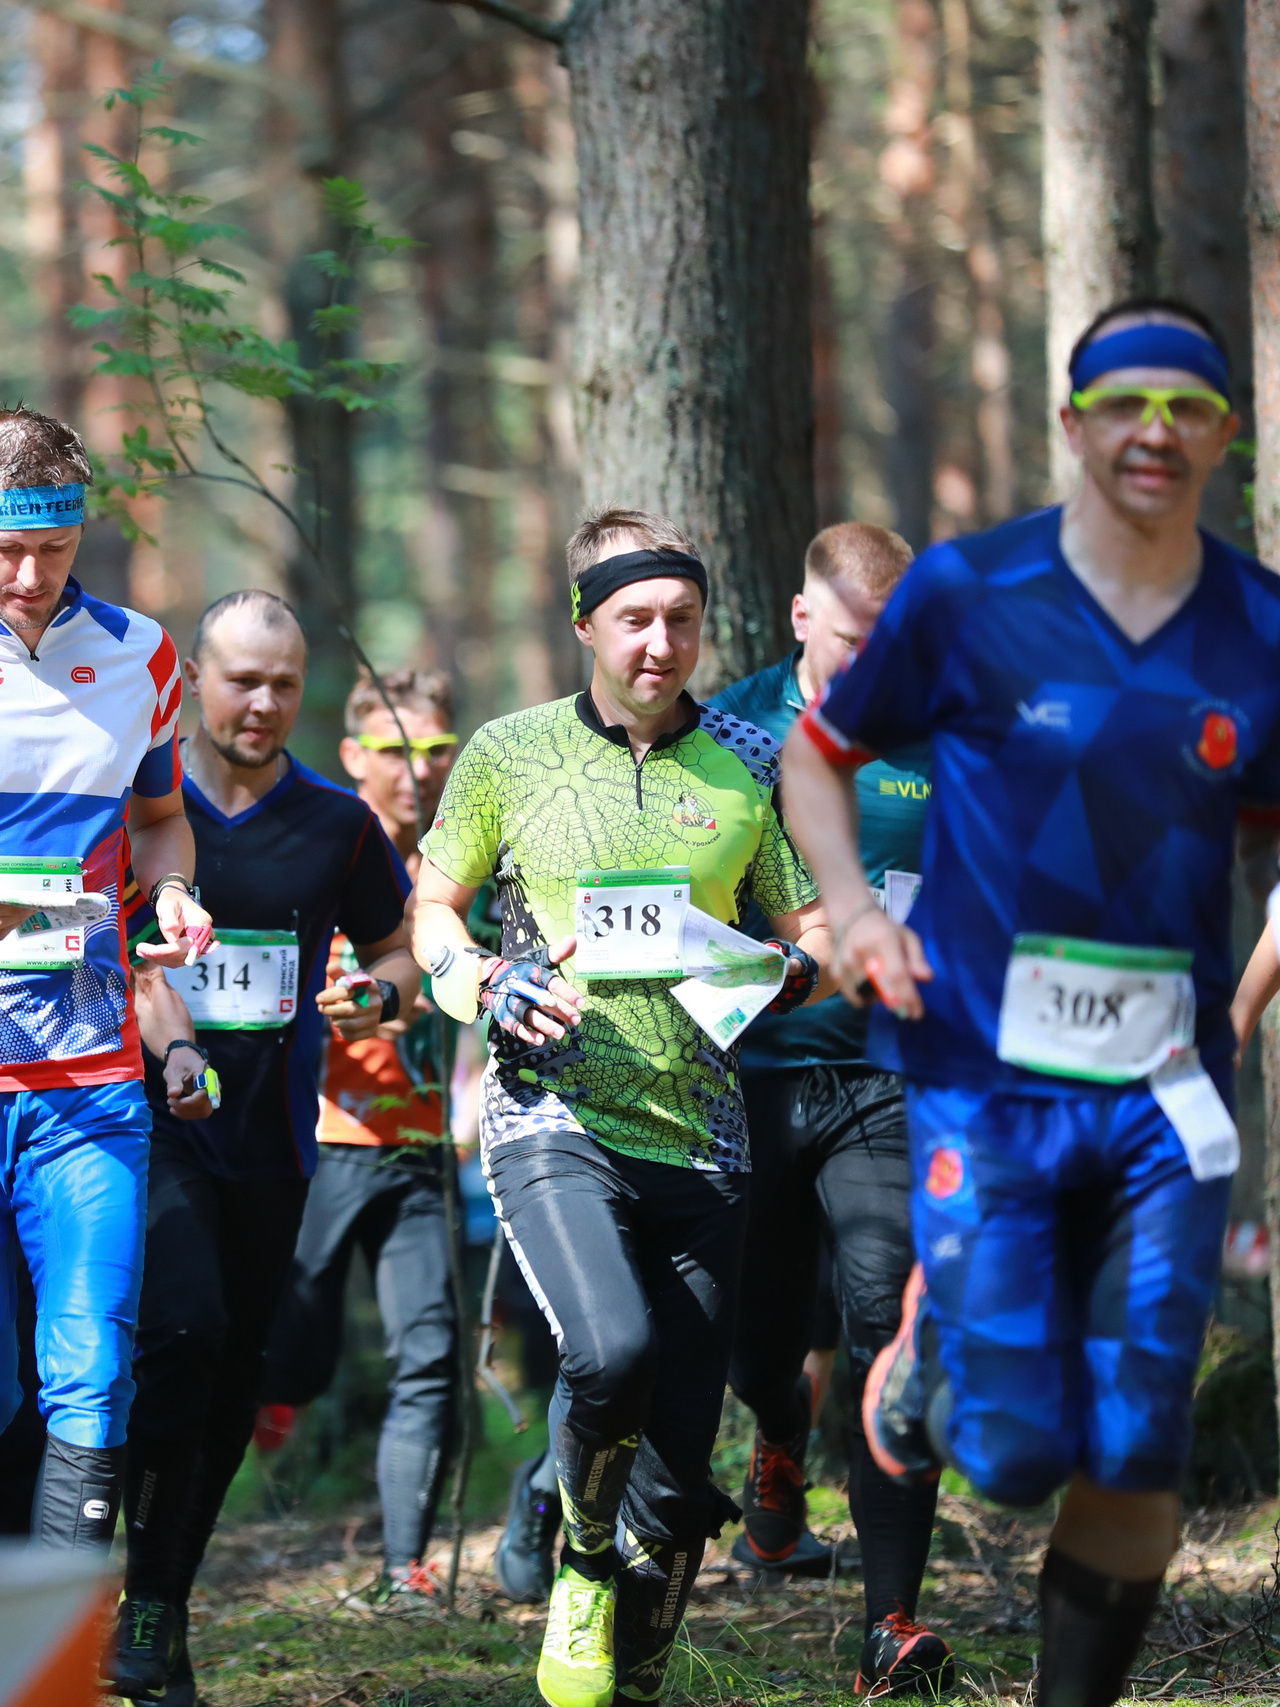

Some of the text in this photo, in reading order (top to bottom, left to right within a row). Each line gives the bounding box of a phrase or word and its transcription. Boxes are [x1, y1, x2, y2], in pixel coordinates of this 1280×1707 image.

[594, 903, 662, 937] 318
[191, 962, 251, 991] 314
[1038, 983, 1126, 1032] 308
[660, 1551, 688, 1629] ORIENTEERING
[650, 1607, 661, 1629] SPORT
